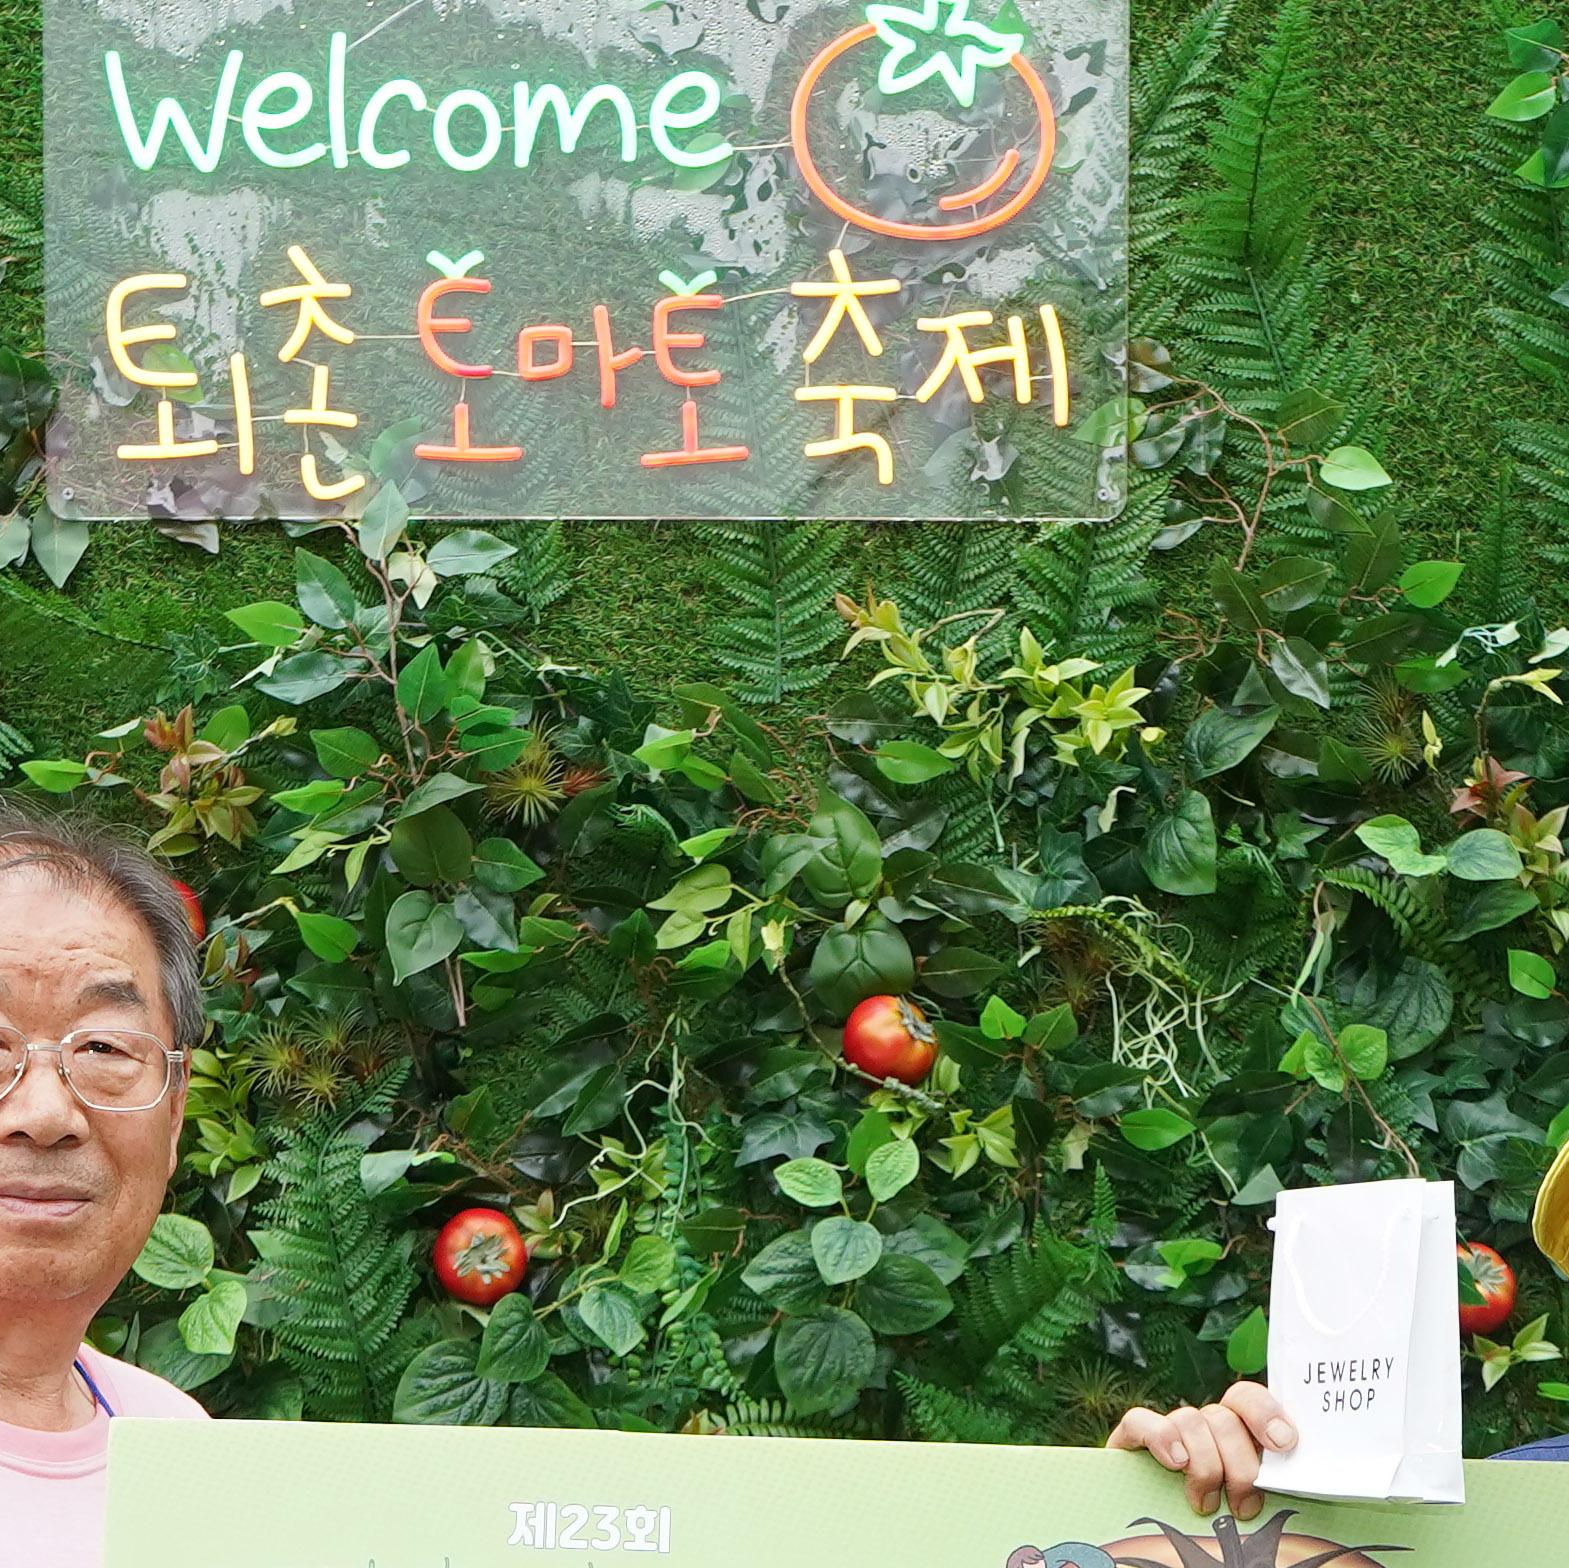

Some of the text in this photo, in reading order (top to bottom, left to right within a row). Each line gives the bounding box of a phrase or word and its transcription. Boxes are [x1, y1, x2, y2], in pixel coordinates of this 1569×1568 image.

[105, 31, 733, 173] Welcome
[106, 246, 1069, 501] 퇴촌 토마토 축제
[1303, 1356, 1394, 1384] JEWELRY
[1321, 1388, 1377, 1413] SHOP
[507, 1500, 673, 1554] 제23회
